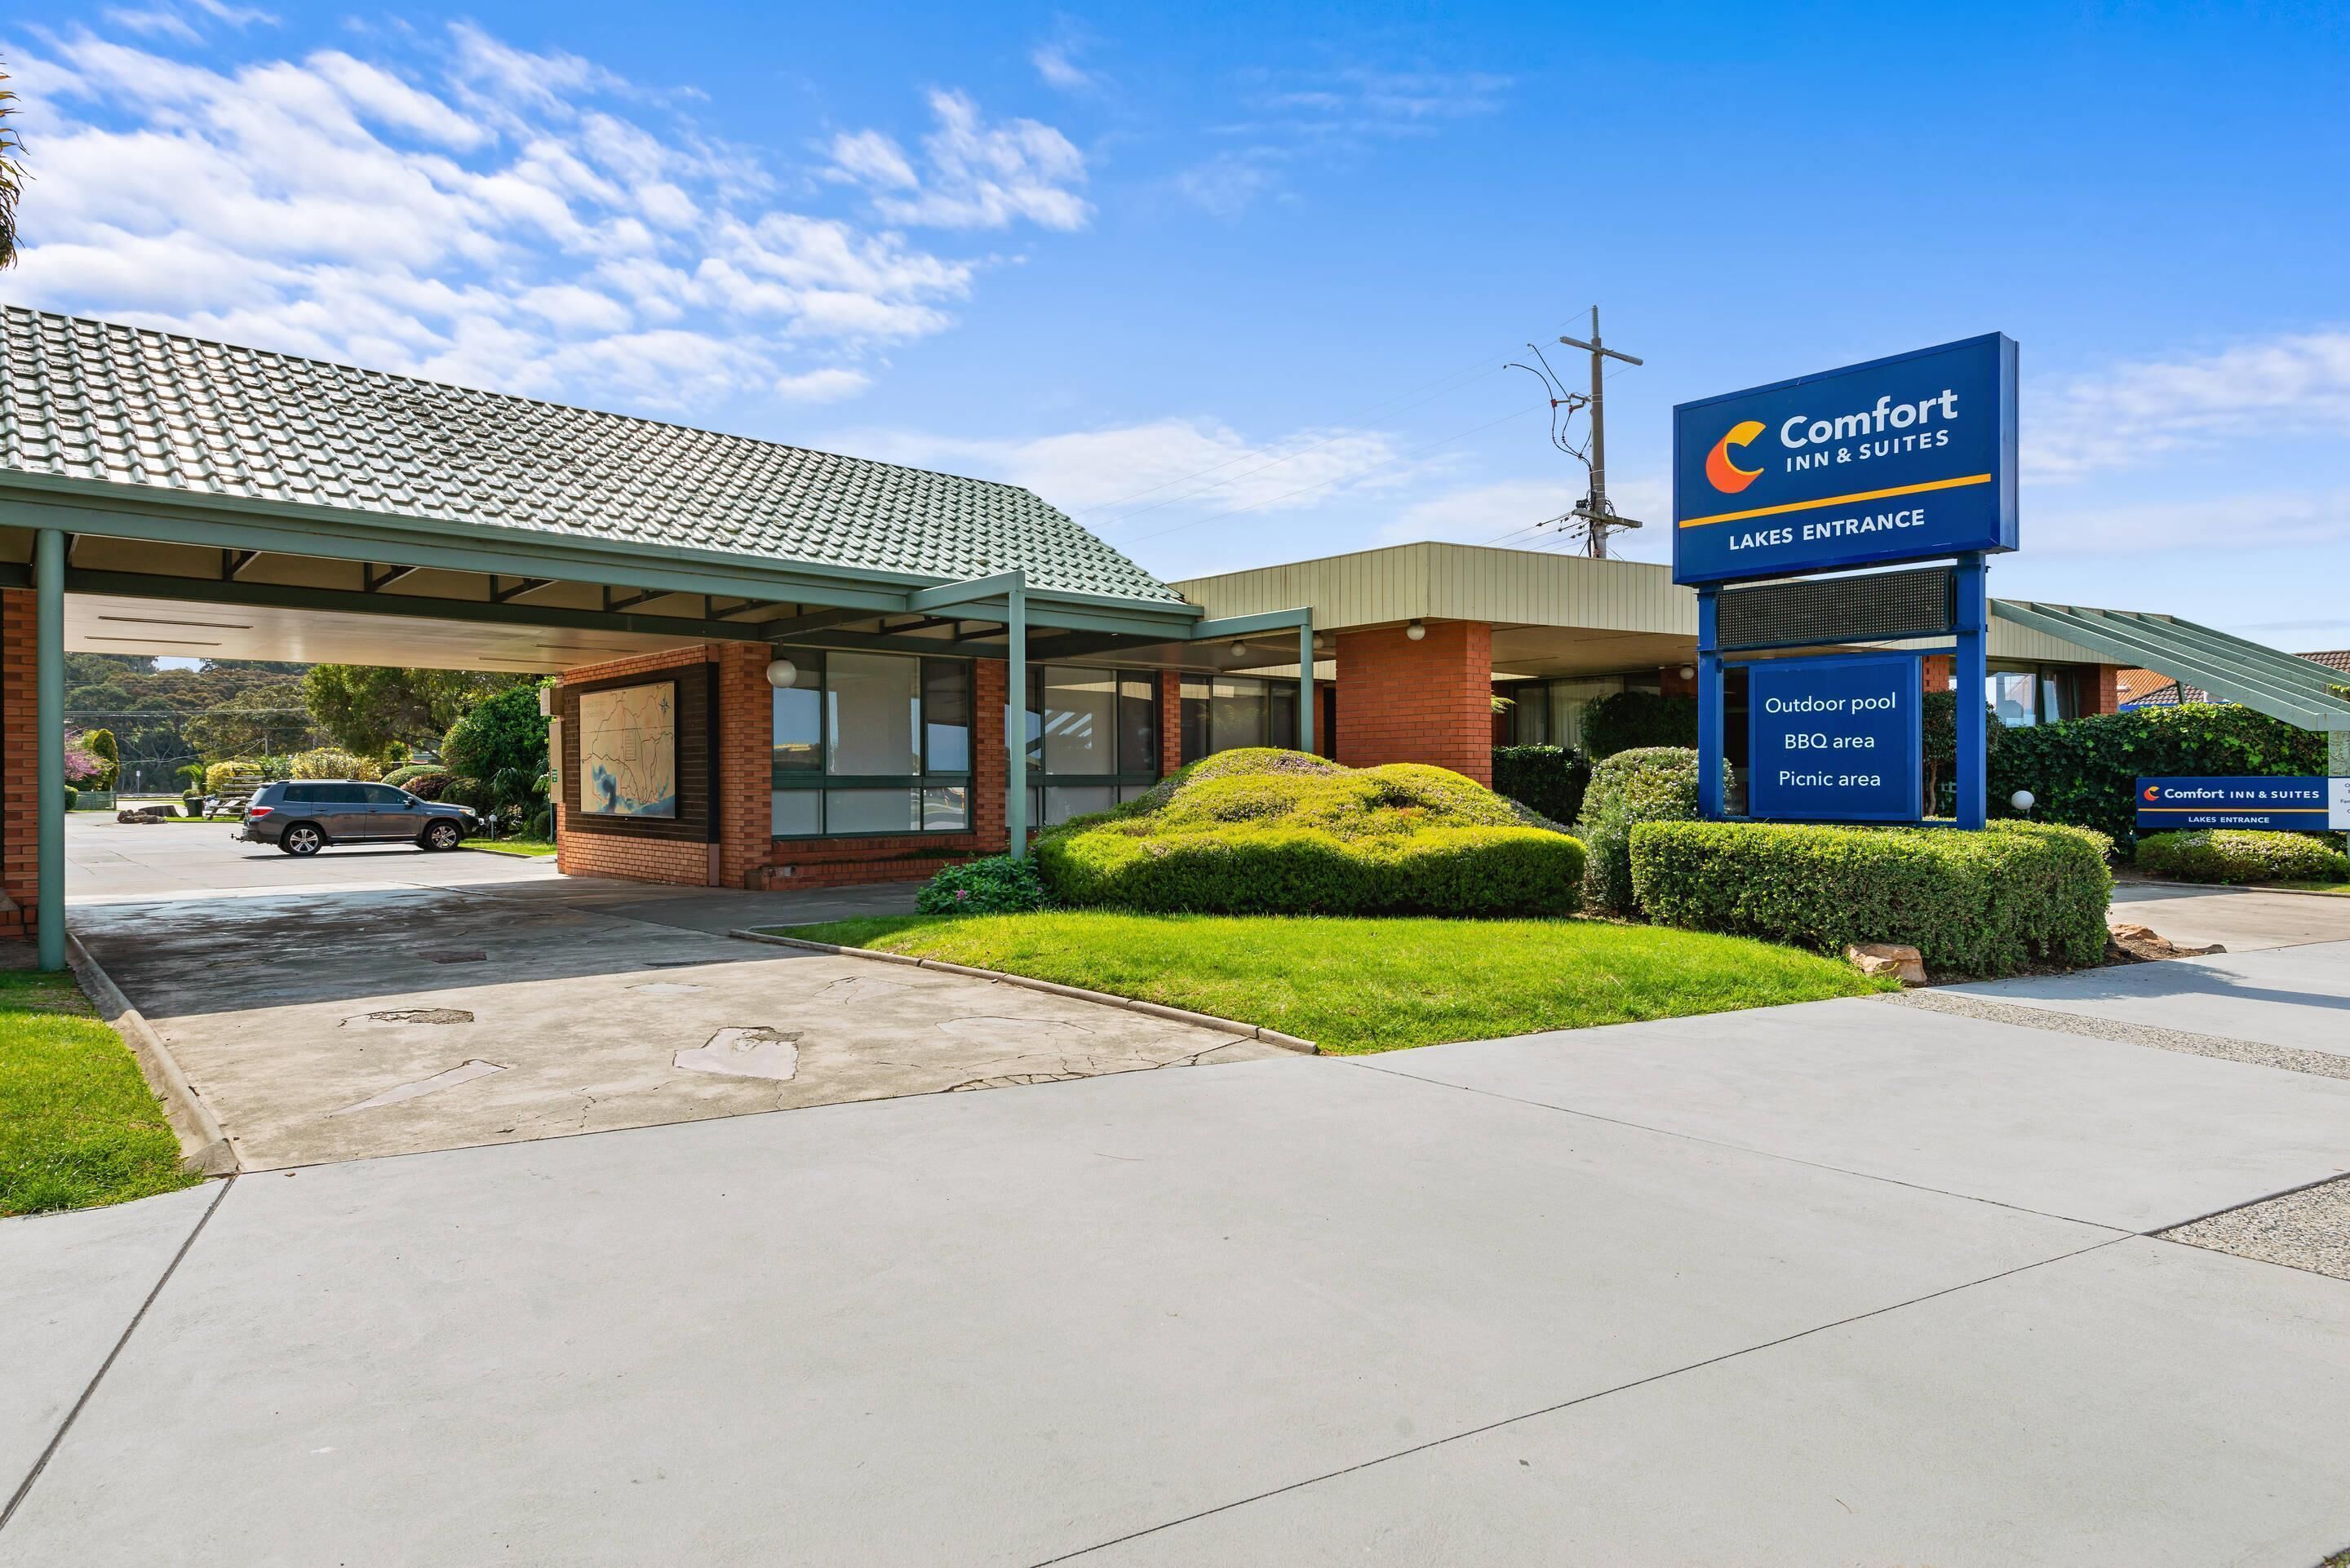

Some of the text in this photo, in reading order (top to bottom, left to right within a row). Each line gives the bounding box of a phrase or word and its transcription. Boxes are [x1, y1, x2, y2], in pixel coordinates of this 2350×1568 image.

[1780, 389, 1958, 449] Comfort
[1787, 429, 1949, 472] INN & SUITES
[1730, 508, 1925, 551] LAKES ENTRANCE
[1765, 691, 1896, 715] Outdoor pool
[1785, 733, 1875, 750] BBQ area
[1779, 770, 1881, 786] Picnic area
[2164, 787, 2320, 799] Comfort INN & SUITES
